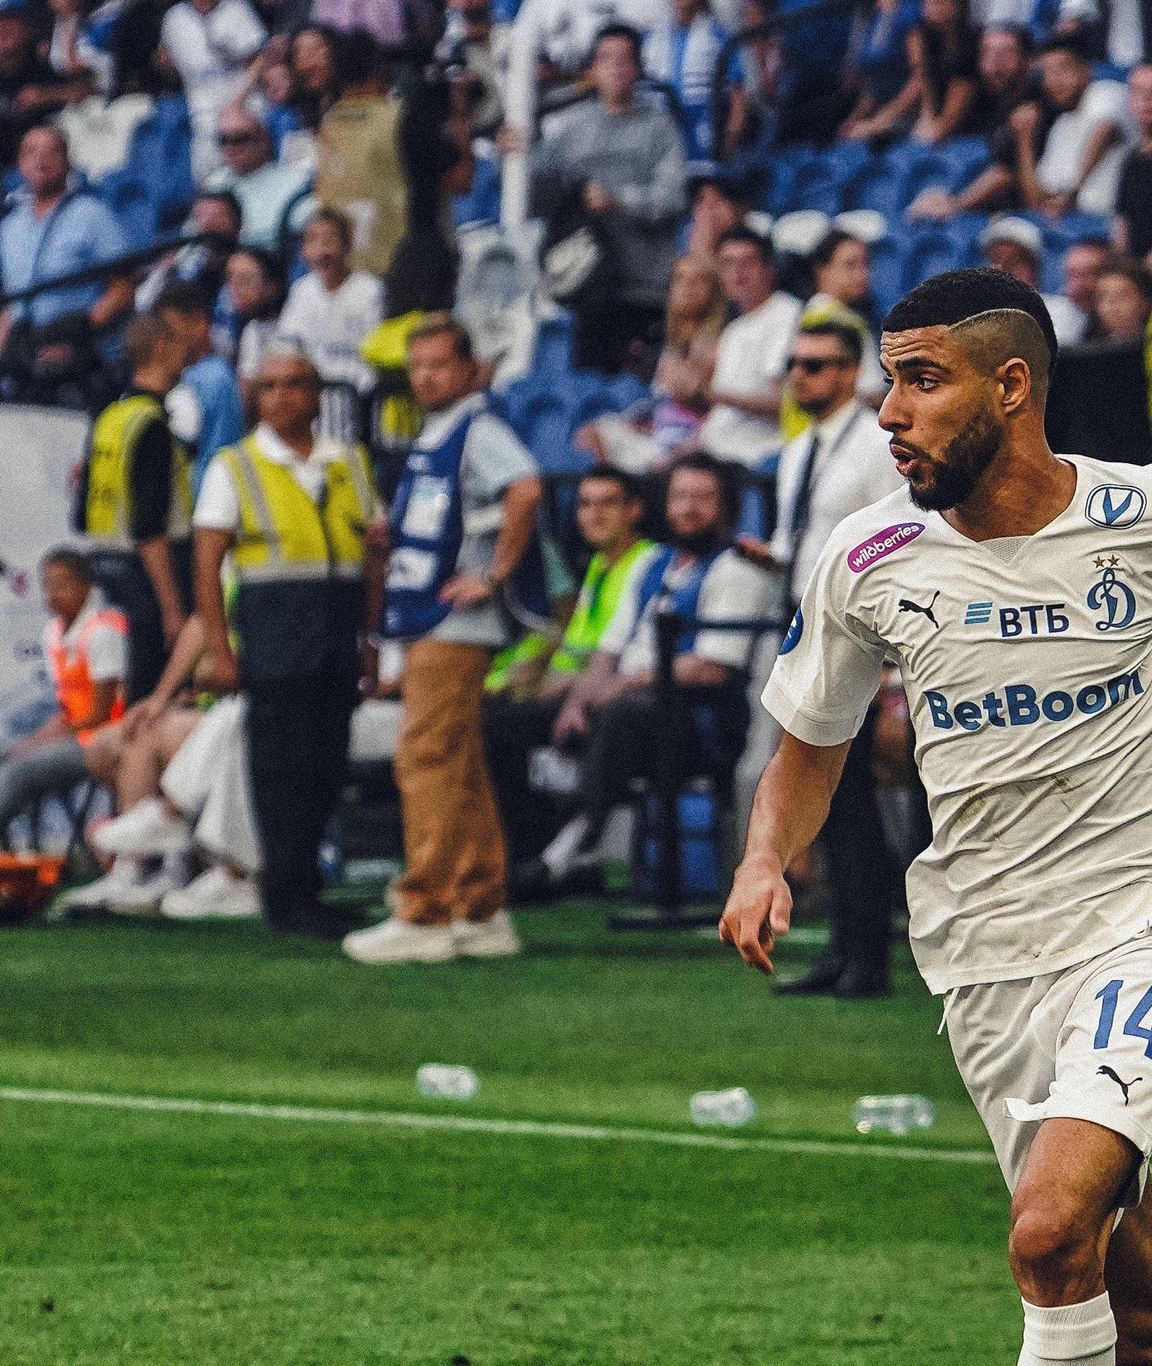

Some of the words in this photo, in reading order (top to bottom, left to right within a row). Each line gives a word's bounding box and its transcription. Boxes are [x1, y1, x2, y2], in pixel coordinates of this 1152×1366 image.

[852, 523, 920, 568] wildberries
[999, 603, 1070, 638] ВТБ
[923, 670, 1145, 731] BetBoom
